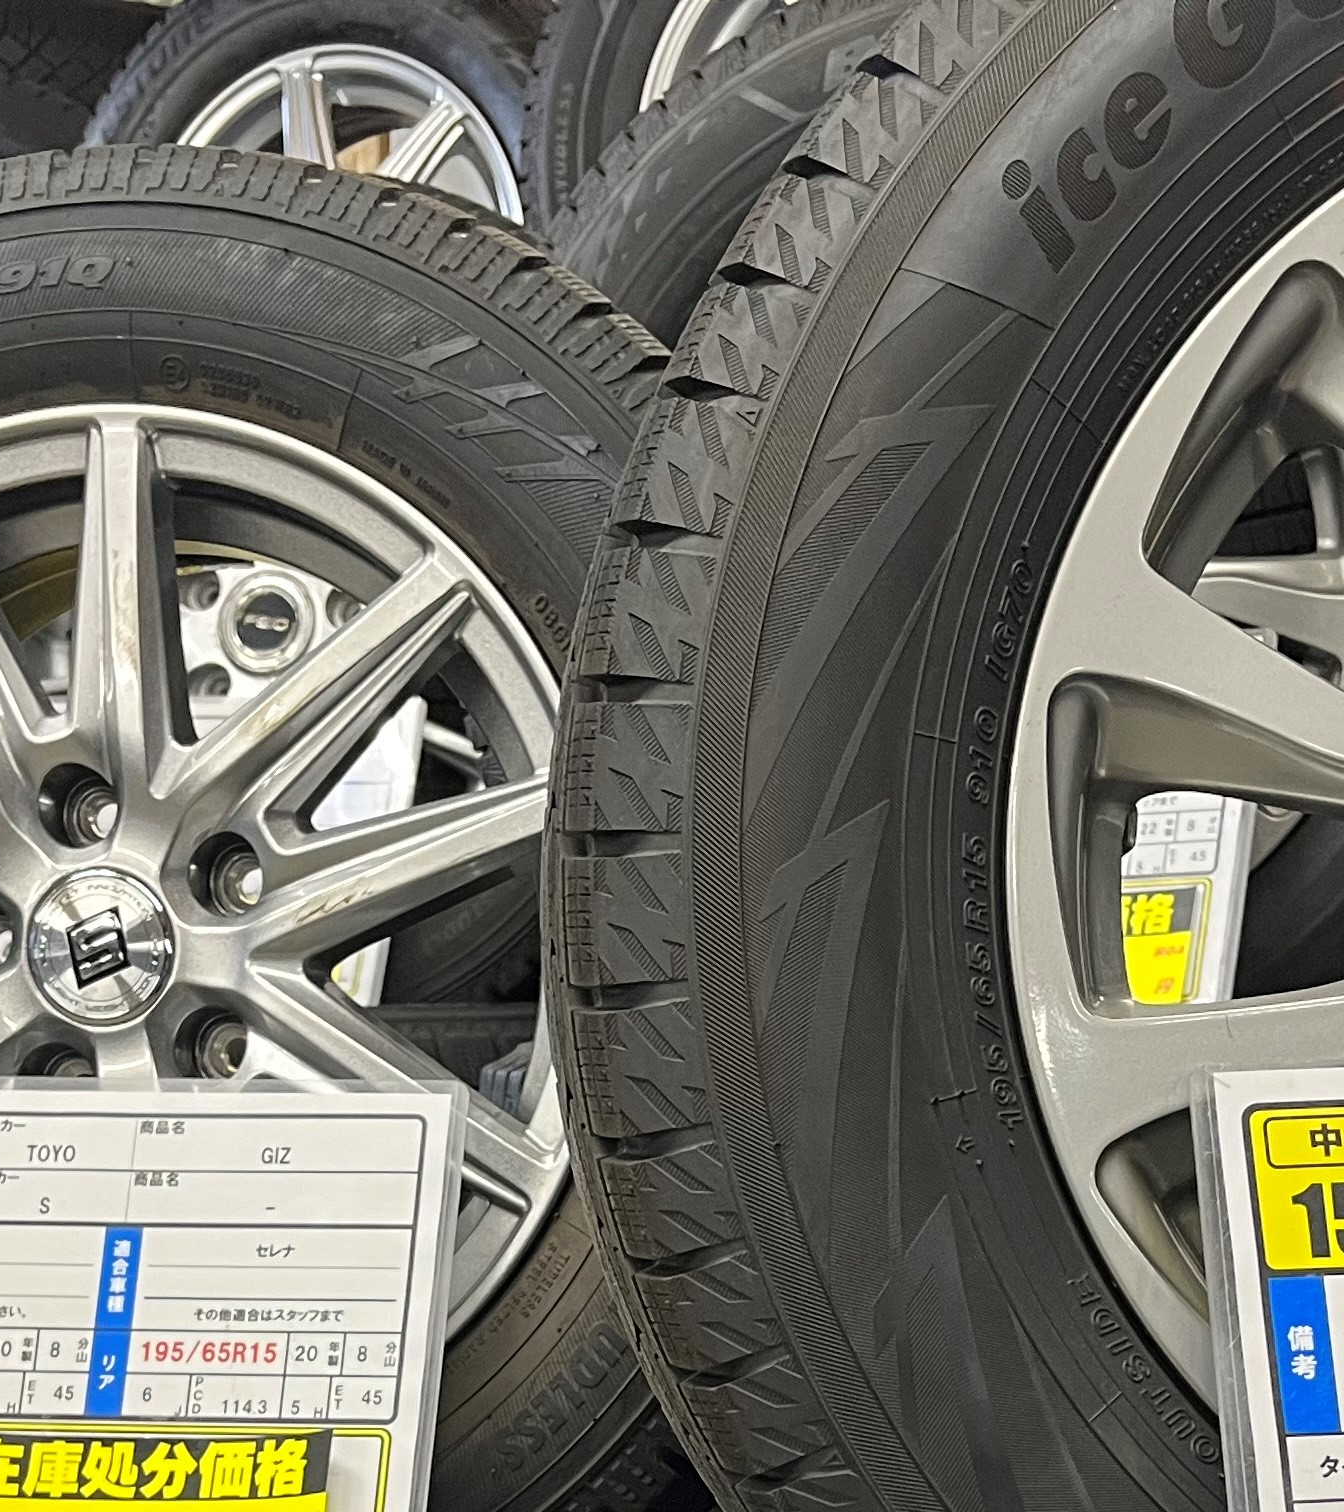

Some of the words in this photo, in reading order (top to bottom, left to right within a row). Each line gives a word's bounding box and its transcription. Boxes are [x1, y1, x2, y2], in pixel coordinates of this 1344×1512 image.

[960, 830, 1026, 1129] 195/65R15
[26, 1144, 75, 1162] TOYO
[260, 1146, 291, 1165] GIZ
[38, 1196, 50, 1214] S
[255, 1243, 295, 1259] セレナ
[49, 1342, 60, 1358] 8
[140, 1340, 278, 1363] 195/65R15
[294, 1344, 318, 1362] 20
[356, 1345, 368, 1362] 8
[1285, 1324, 1318, 1380] 備考
[98, 1354, 116, 1390] リア
[1065, 1270, 1221, 1464] OUTSIDE
[53, 1384, 74, 1401] 45
[141, 1386, 152, 1401] 6
[360, 1389, 383, 1406] 45
[220, 1398, 268, 1415] 114.3
[290, 1399, 300, 1416] 5
